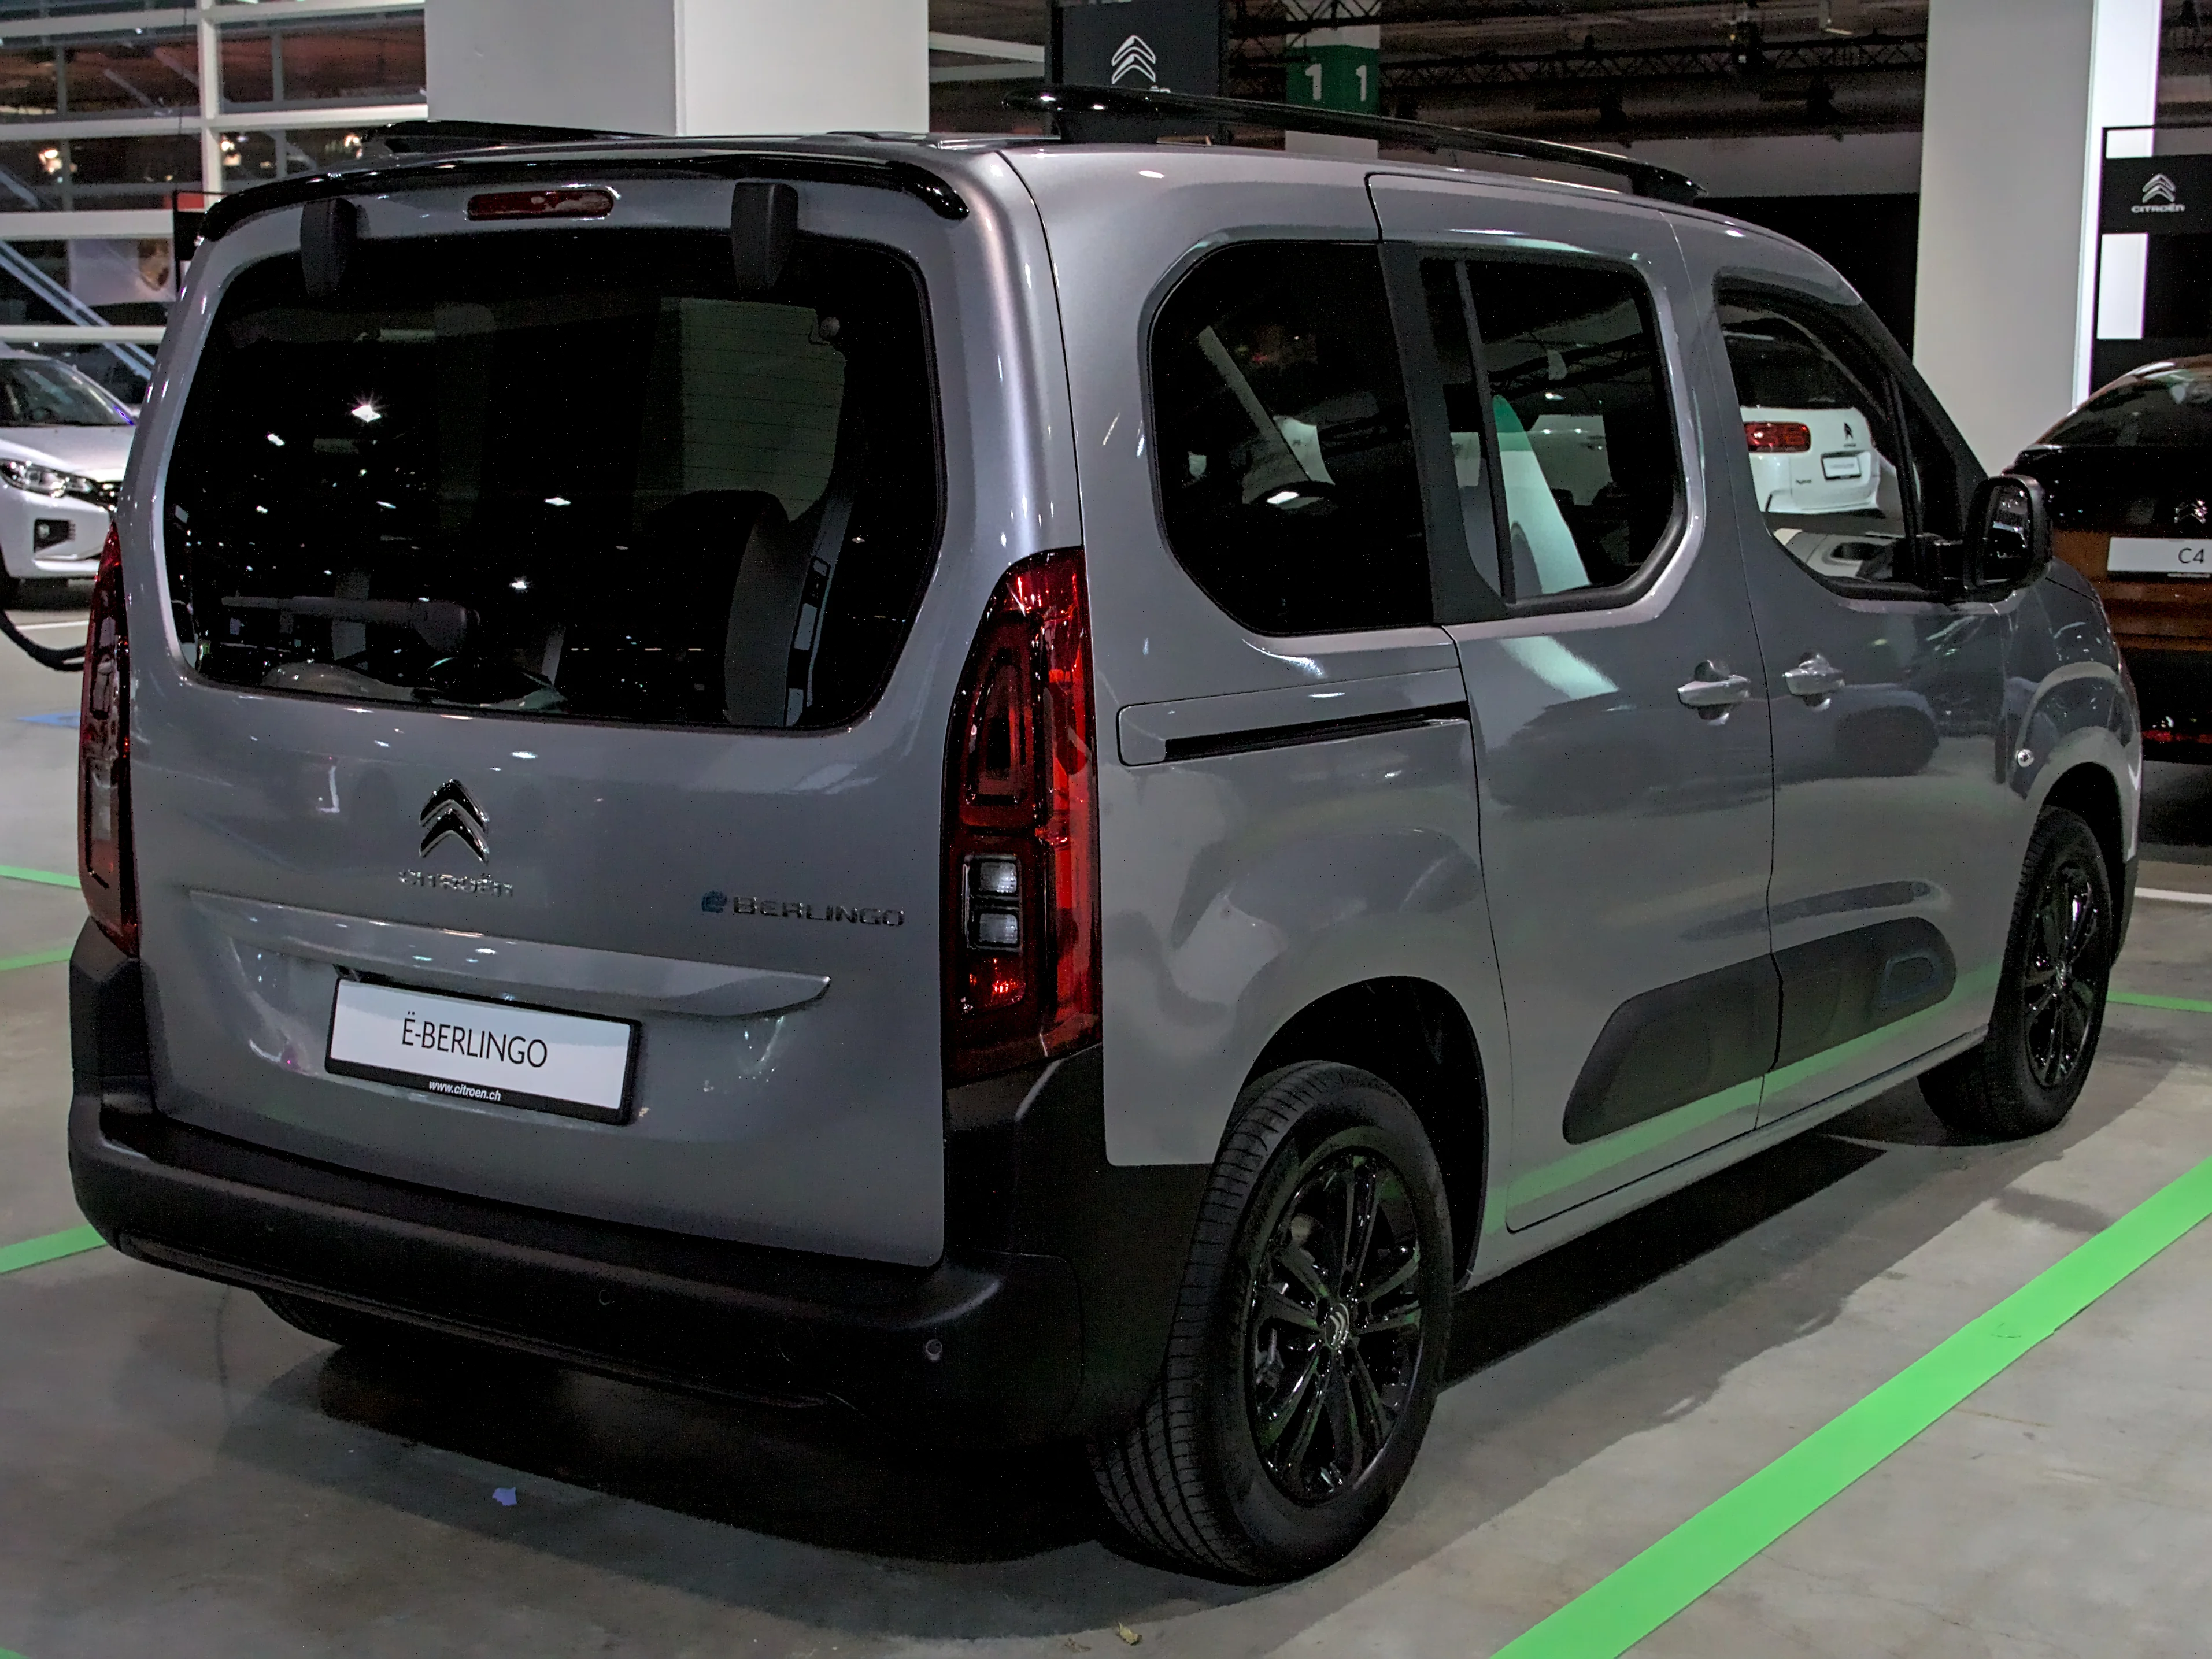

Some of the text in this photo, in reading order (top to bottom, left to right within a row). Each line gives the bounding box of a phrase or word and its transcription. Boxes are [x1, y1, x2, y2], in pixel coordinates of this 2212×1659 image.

[1304, 62, 1323, 101] 1
[1355, 65, 1367, 102] 1
[2178, 547, 2204, 564] C4
[733, 896, 905, 926] BERLINGO
[402, 1010, 548, 1068] Ë-BERLINGO
[428, 1080, 502, 1102] www.citroen.ch
